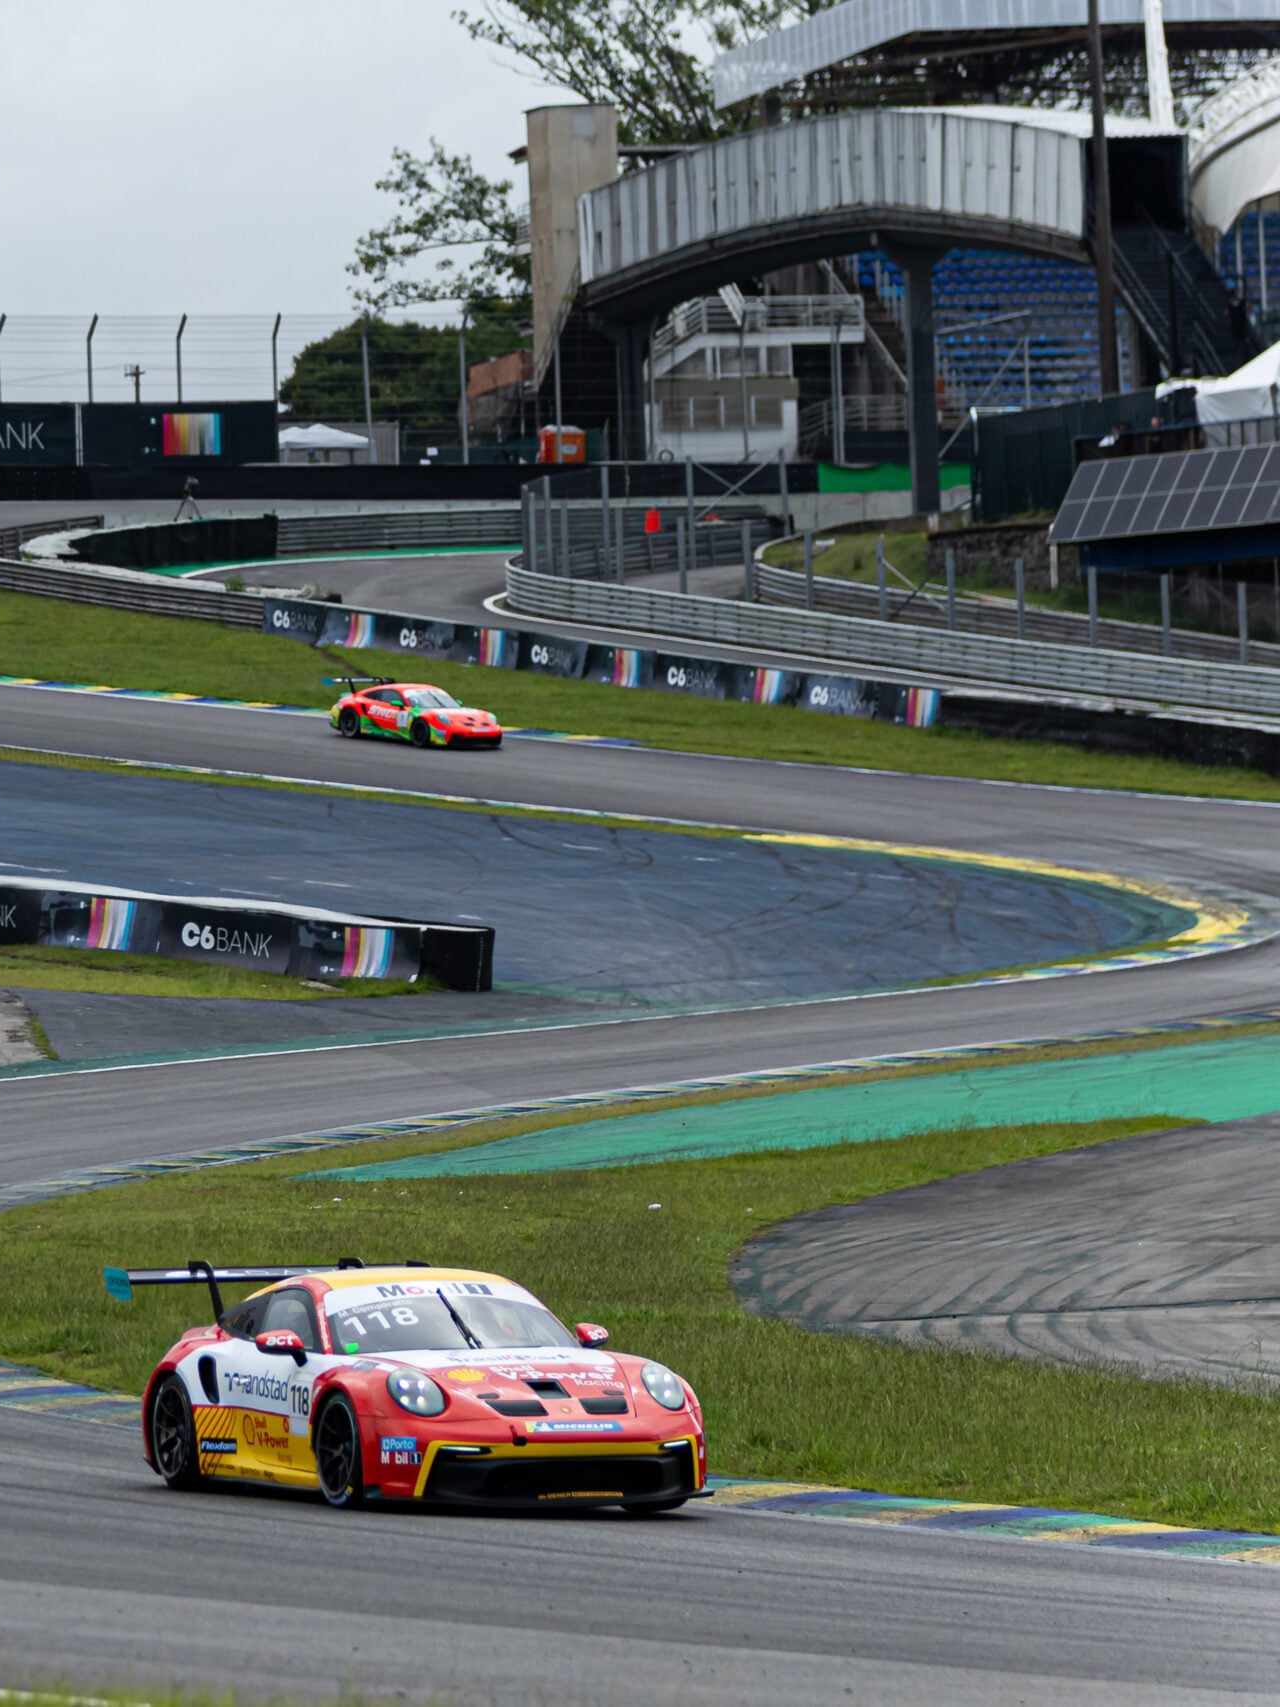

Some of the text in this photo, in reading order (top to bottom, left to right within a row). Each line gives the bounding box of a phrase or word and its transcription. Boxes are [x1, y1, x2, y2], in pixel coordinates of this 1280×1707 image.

[343, 1307, 419, 1335] 118
[266, 1334, 295, 1347] act
[489, 1365, 537, 1373] Shell
[574, 1379, 625, 1389] Racing
[290, 1385, 309, 1416] 118
[256, 1432, 289, 1449] V-Power
[390, 1438, 414, 1450] Porto
[381, 1451, 408, 1464] Mbil
